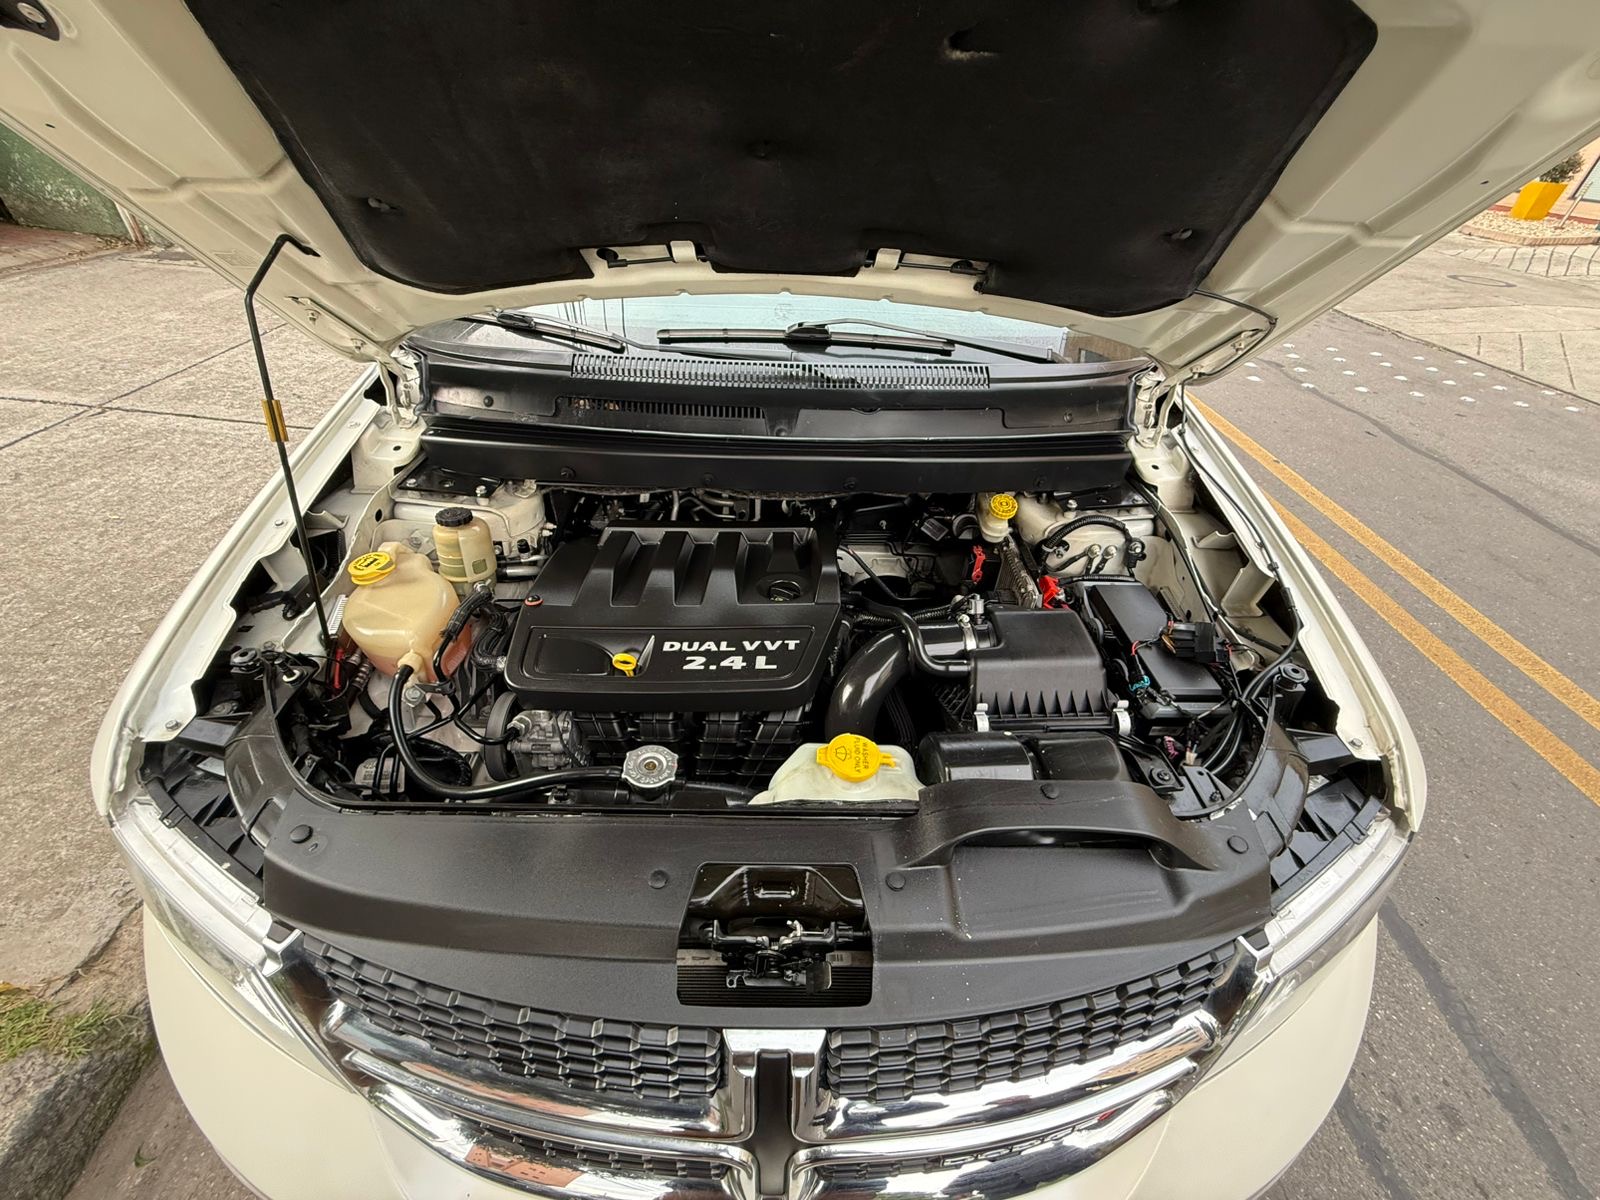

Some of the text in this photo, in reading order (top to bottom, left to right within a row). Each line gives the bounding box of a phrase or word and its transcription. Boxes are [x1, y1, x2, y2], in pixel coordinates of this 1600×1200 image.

[662, 639, 800, 652] DUAL VVT
[862, 742, 870, 769] WASHER
